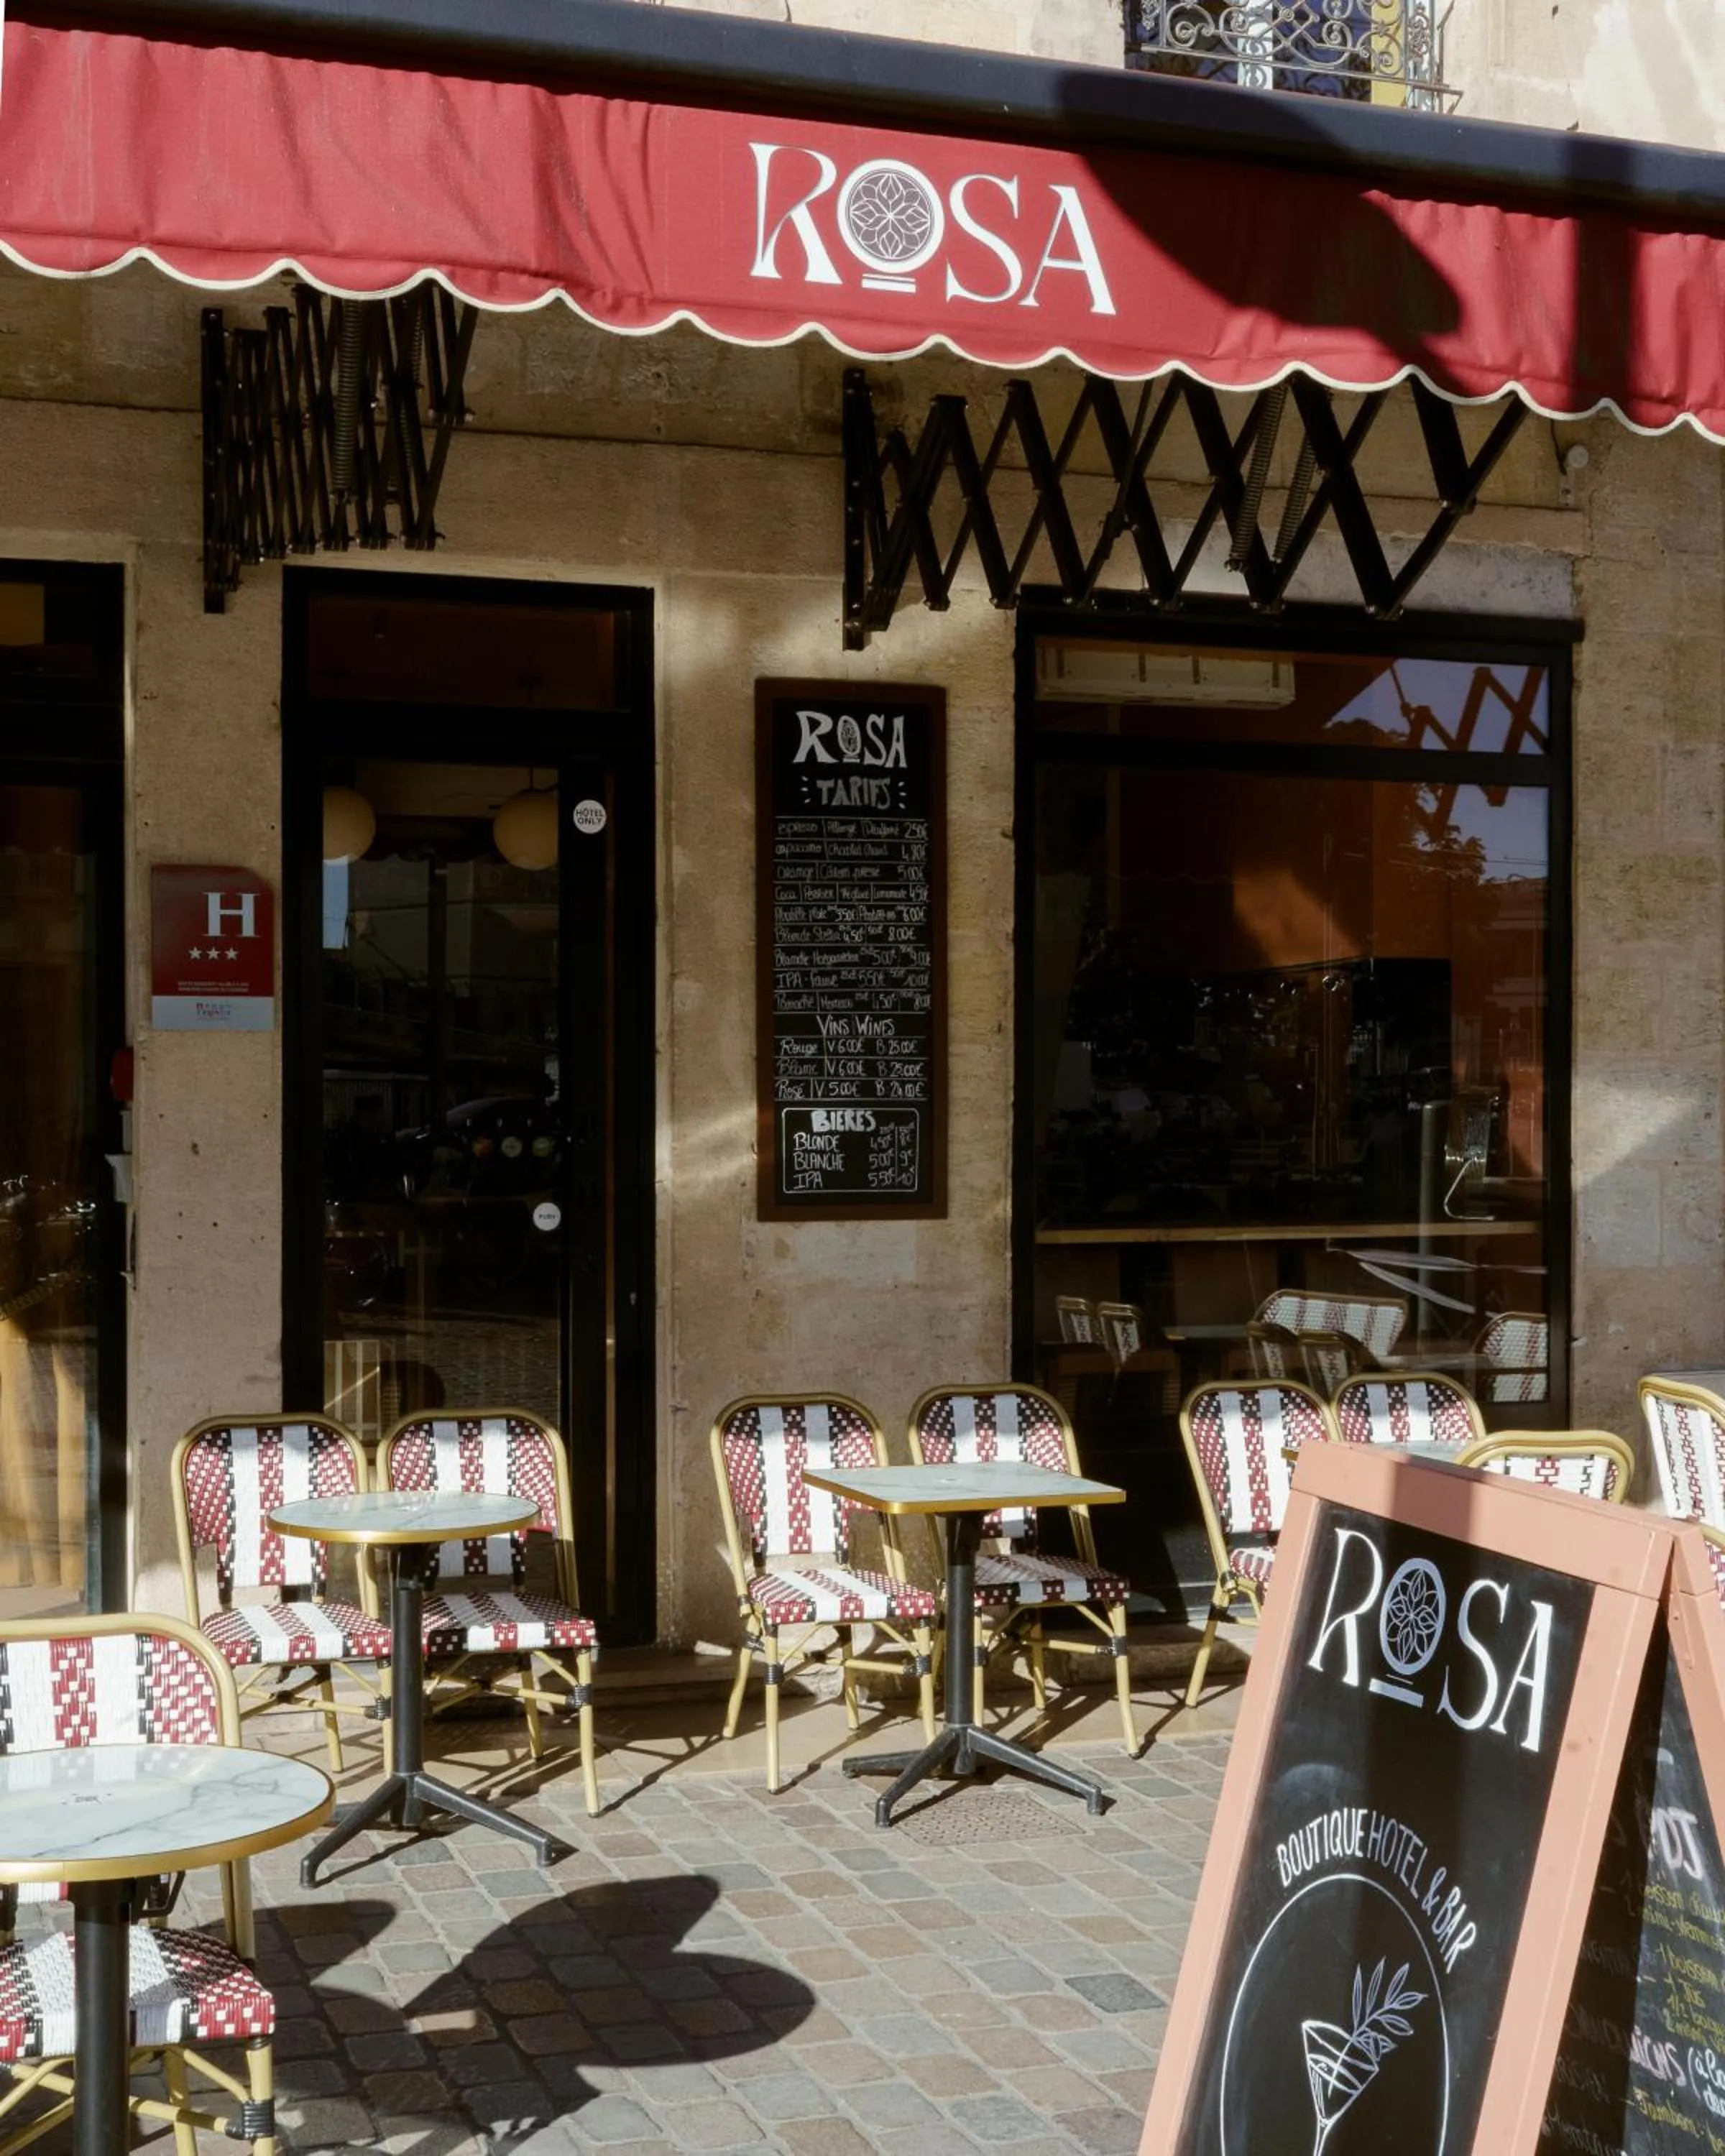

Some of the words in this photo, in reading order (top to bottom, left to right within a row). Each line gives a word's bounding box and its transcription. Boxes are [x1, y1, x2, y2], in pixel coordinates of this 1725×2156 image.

[749, 142, 1116, 315] ROSA
[793, 711, 908, 768] ROSA
[816, 776, 891, 809] TARIFS
[577, 817, 602, 826] ONLY
[202, 892, 261, 937] H
[776, 972, 804, 988] IPA
[827, 1040, 836, 1053] V
[876, 1039, 886, 1055] B
[876, 1060, 887, 1077] B
[814, 1079, 825, 1097] V
[875, 1080, 885, 1097] B
[811, 1110, 876, 1133] BIERES
[793, 1132, 841, 1153] BLONDE
[793, 1151, 845, 1171] BLANCHE
[793, 1171, 823, 1189] IPA
[1309, 1528, 1554, 1752] ROSA
[1276, 1807, 1368, 1888] BOUTIQUE
[1366, 1810, 1428, 1899] HOTEL
[1421, 1866, 1446, 1916] &
[1431, 1885, 1476, 1974] BAR
